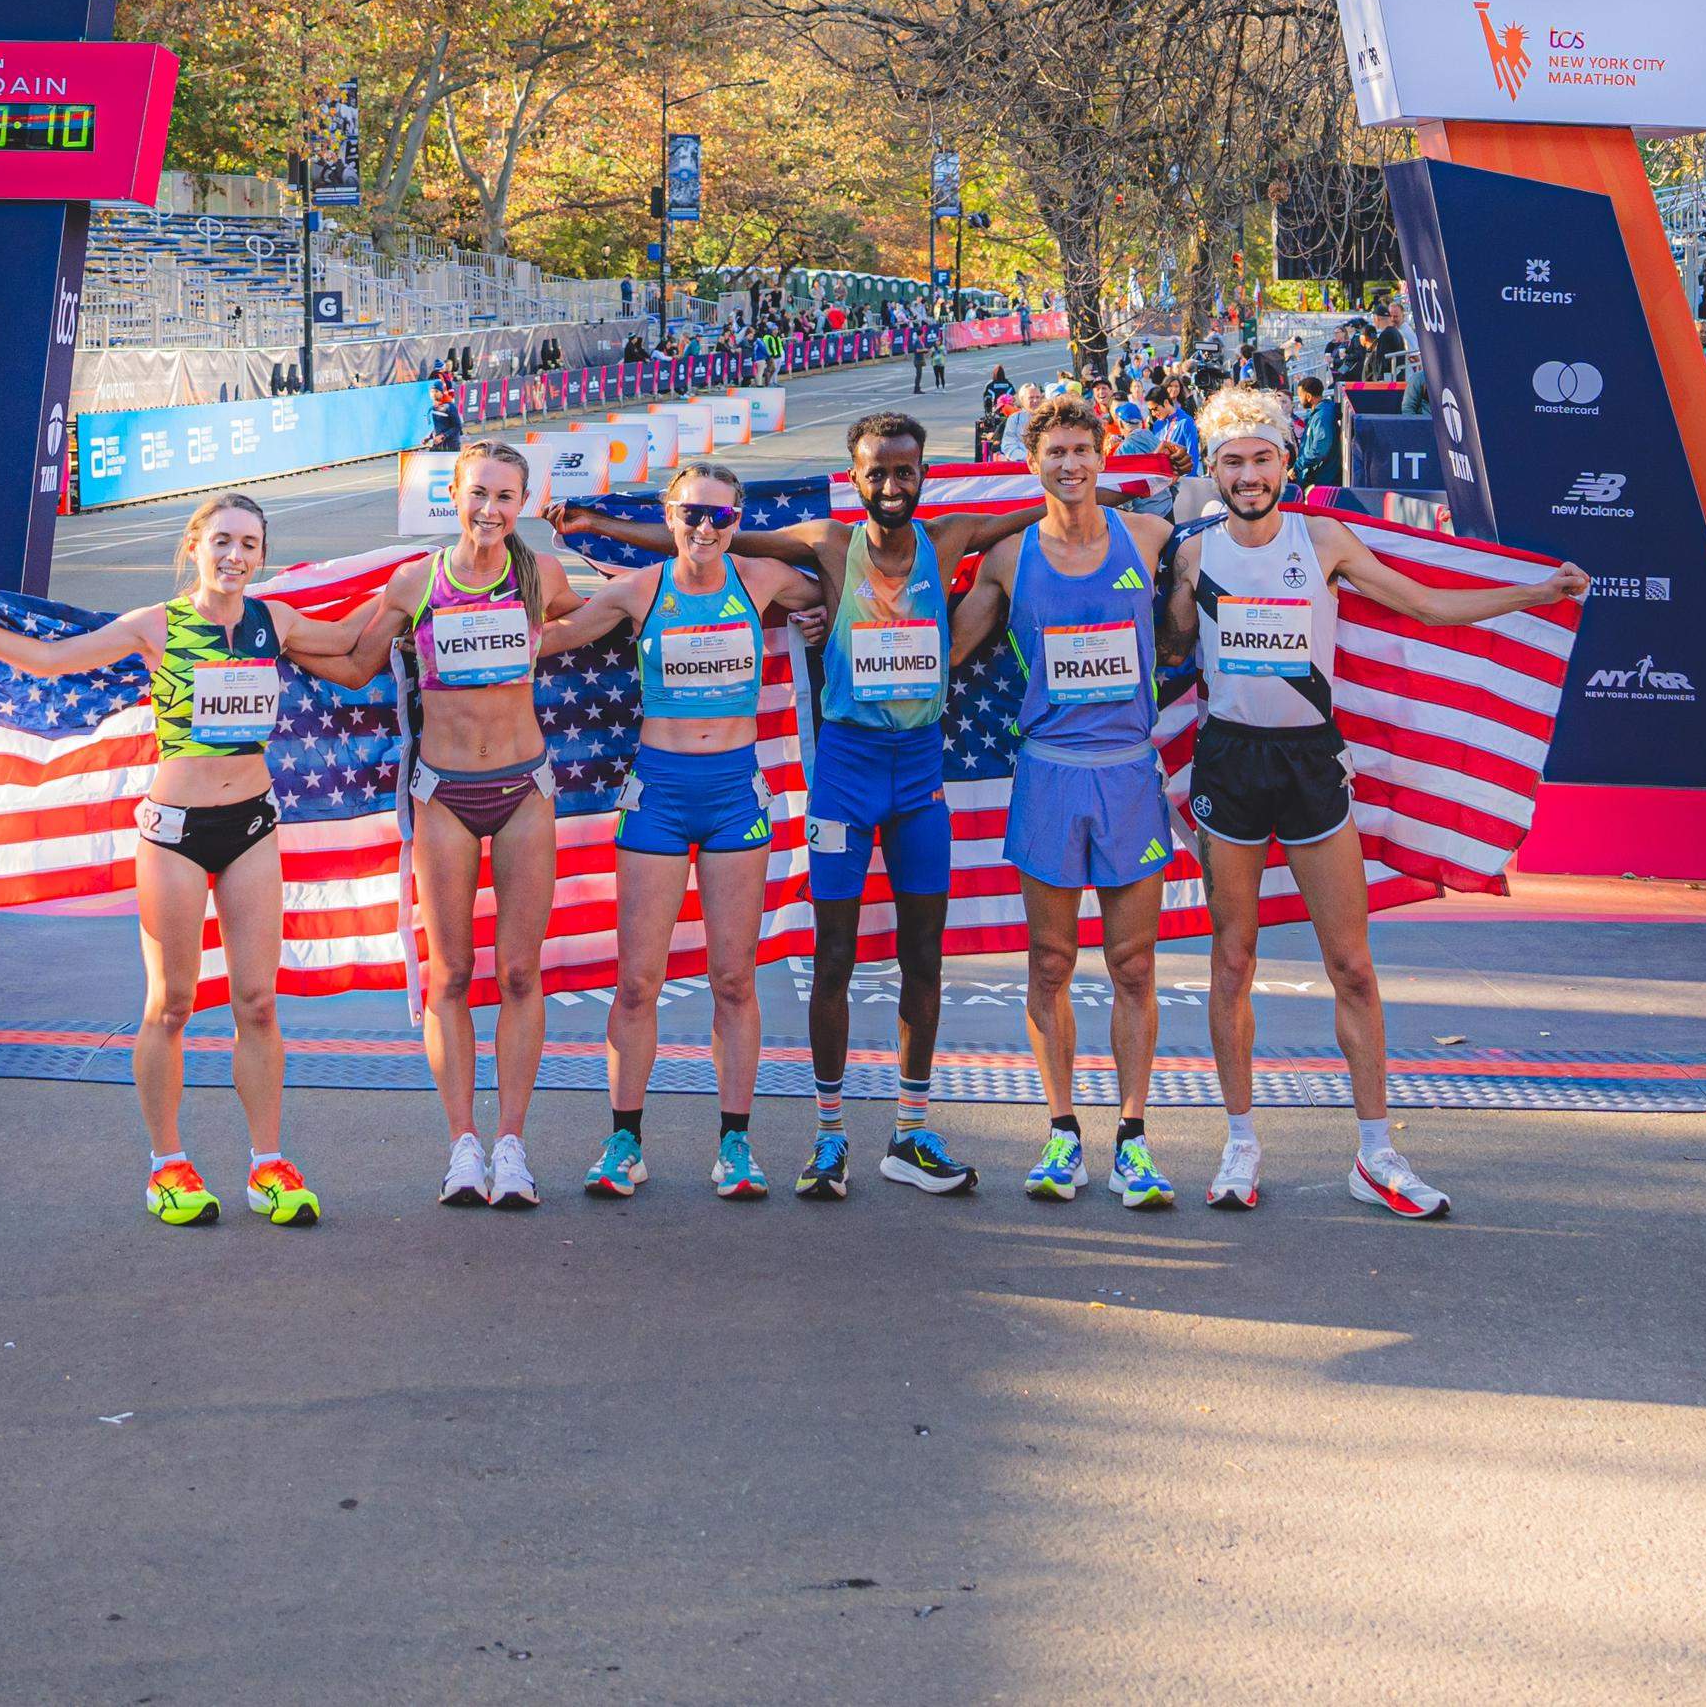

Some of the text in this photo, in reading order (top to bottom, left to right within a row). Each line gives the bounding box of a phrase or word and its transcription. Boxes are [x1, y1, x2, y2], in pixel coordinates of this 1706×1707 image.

[1549, 27, 1584, 50] tcs
[1549, 55, 1666, 72] NEW YORK CITY
[1548, 71, 1637, 87] MARATHON
[938, 272, 947, 283] F
[1412, 264, 1445, 334] tcs
[1501, 286, 1573, 304] Citizens
[57, 277, 79, 345] tcs
[319, 297, 337, 317] G
[1534, 403, 1599, 416] mastercard
[561, 469, 589, 477] balance
[1391, 451, 1427, 480] IT
[1448, 449, 1475, 483] TATA
[40, 465, 59, 493] TATA
[428, 507, 459, 518] Abbot
[1551, 504, 1635, 519] new balance
[1590, 576, 1641, 588] NITED
[1591, 587, 1641, 598] LINES
[437, 632, 527, 655] VENTERS
[1220, 631, 1309, 650] BARRAZA
[664, 656, 754, 676] RODENFELS
[855, 655, 938, 674] MUHUMED
[1053, 656, 1133, 679] PRAKEL
[200, 694, 275, 715] HURLEY
[1631, 692, 1654, 700] ROAD
[1656, 693, 1695, 702] RUNNERS
[142, 808, 161, 834] 52
[809, 824, 819, 844] 2
